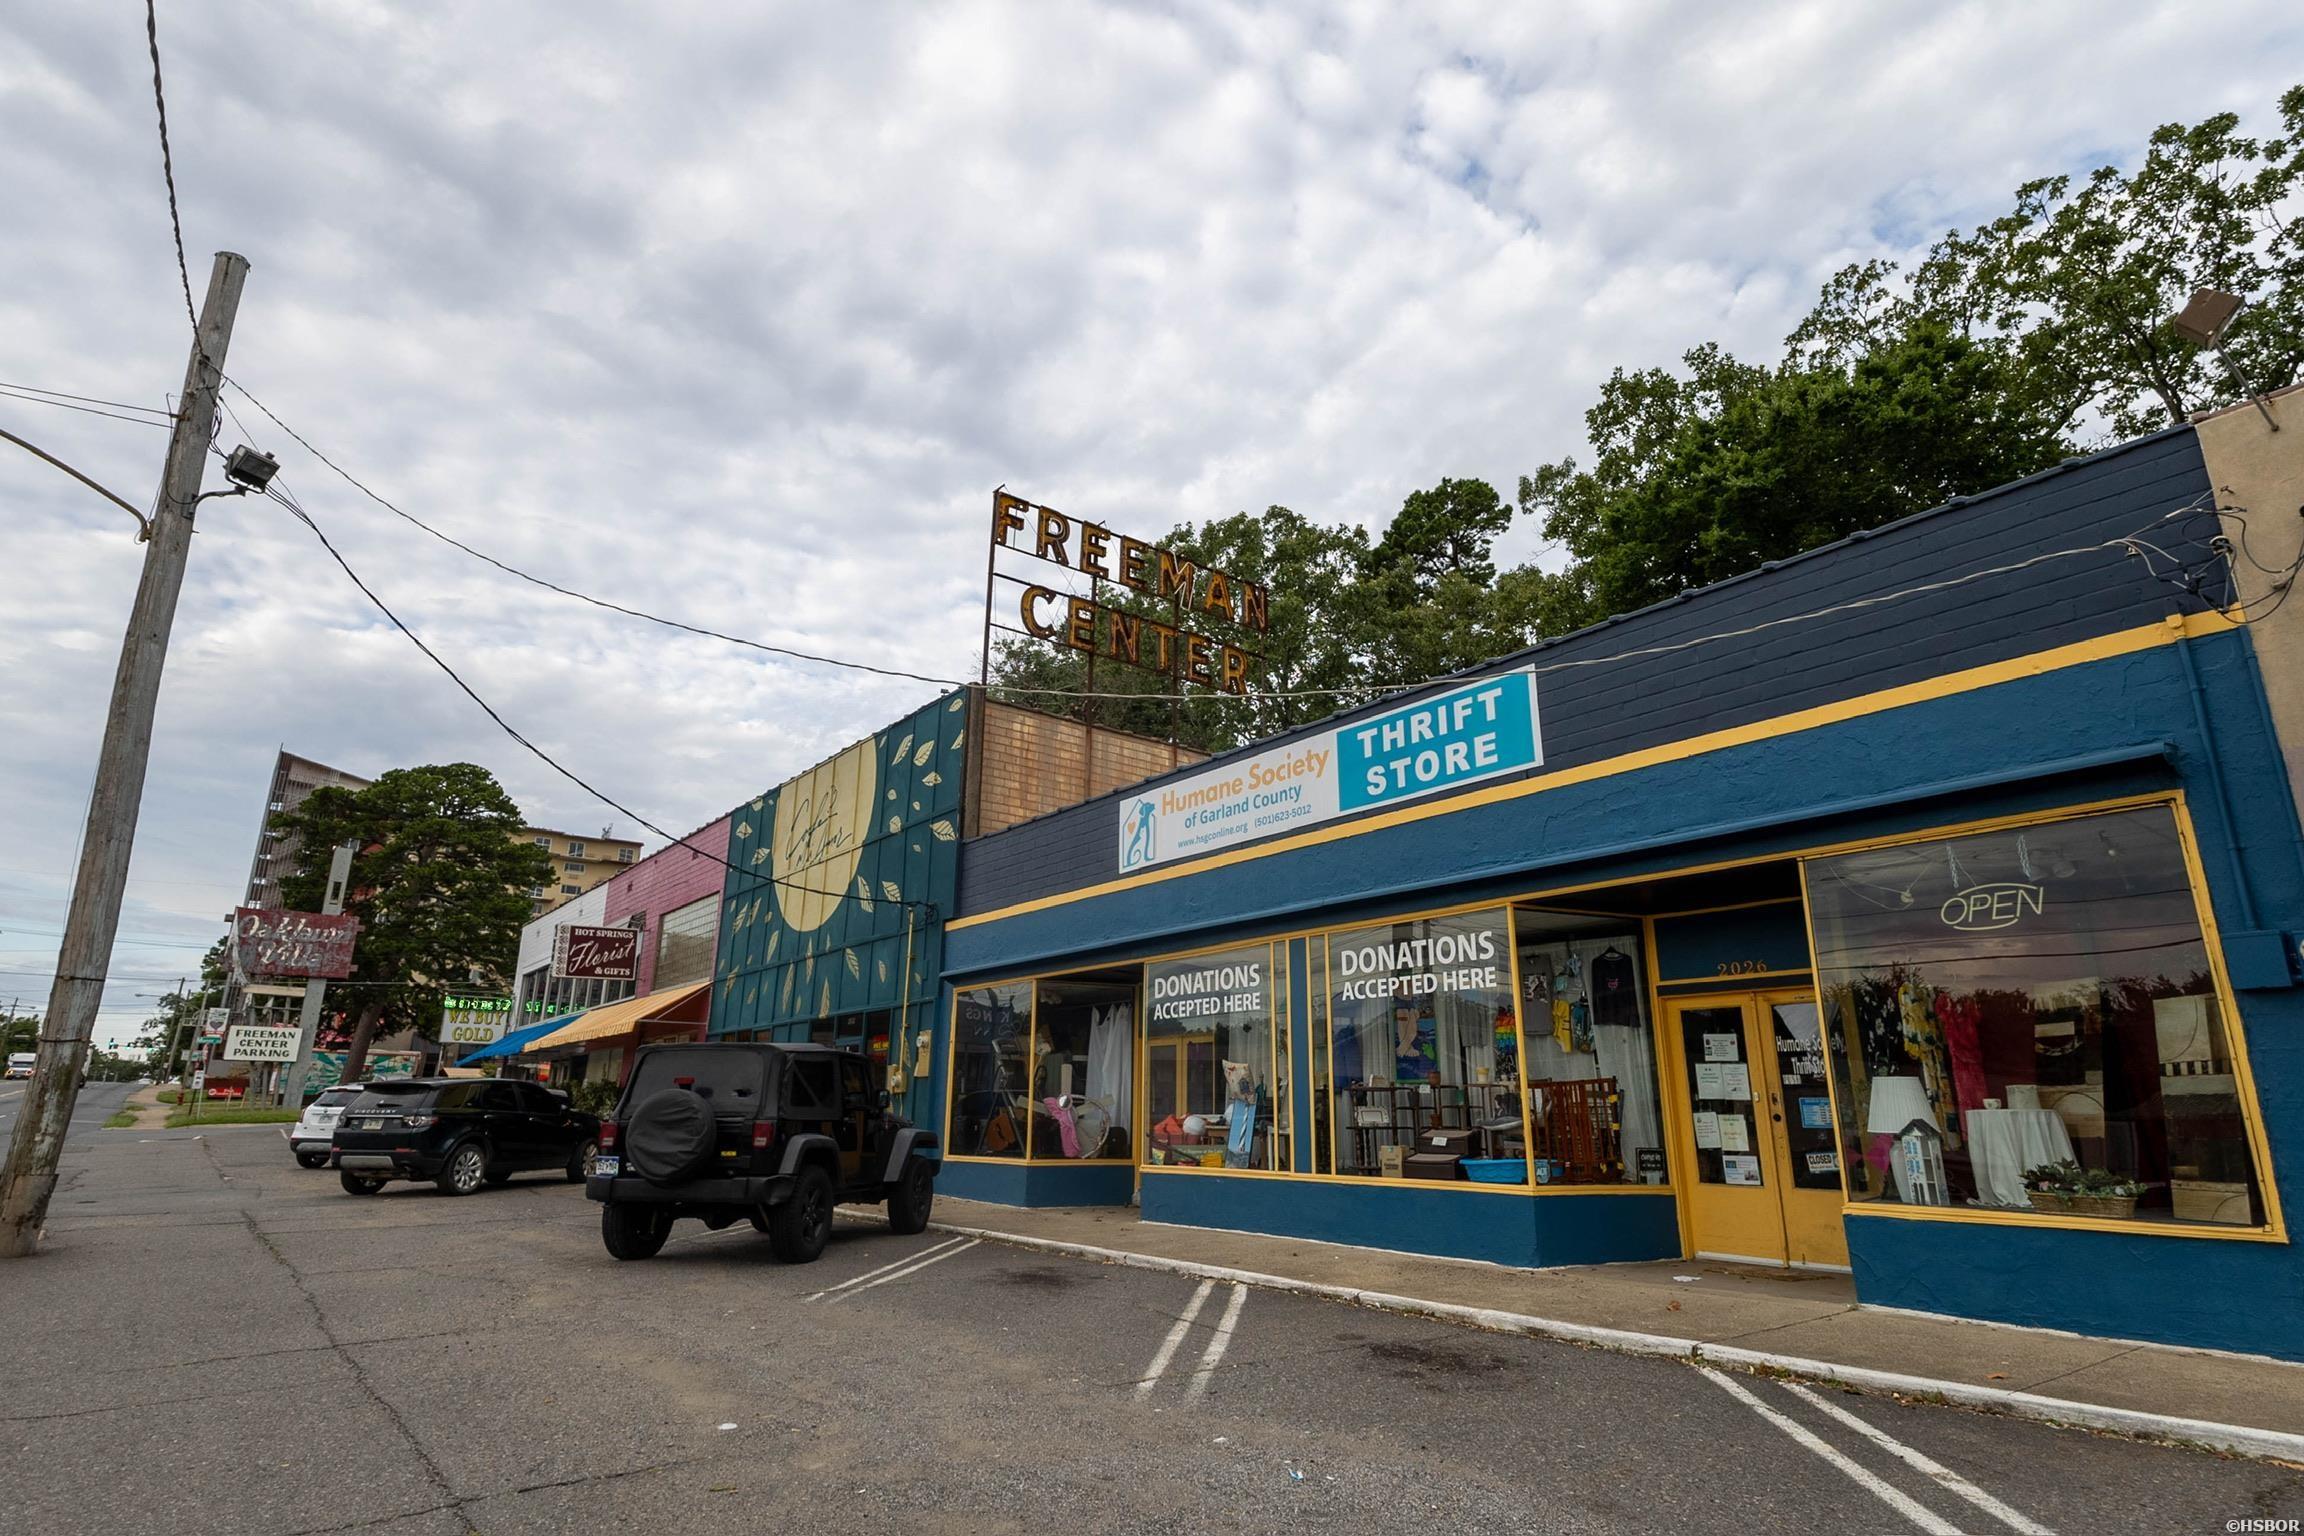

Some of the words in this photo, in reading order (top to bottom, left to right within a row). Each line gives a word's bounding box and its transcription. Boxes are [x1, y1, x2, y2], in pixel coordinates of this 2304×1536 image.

[995, 492, 1269, 633] FREEMAN
[1021, 585, 1248, 696] CENTER
[1357, 687, 1502, 758] THRIFT
[1366, 732, 1499, 796] STORE
[1161, 777, 1244, 816] Humane
[1248, 749, 1330, 791] Society
[1184, 811, 1198, 829] of
[1199, 797, 1250, 824] Garland
[1253, 784, 1302, 809] County
[1177, 822, 1249, 848] www.hsgconline.org
[1254, 804, 1312, 828] (501)623-5012
[1941, 887, 2043, 924] OPEN
[575, 928, 595, 937] HOT
[596, 930, 634, 939] SPRINGS
[569, 939, 635, 973] Florist
[1341, 931, 1495, 976] DONATIONS
[1717, 959, 1767, 976] 2026
[594, 967, 602, 975] &
[604, 967, 631, 976] GIFTS
[1154, 963, 1261, 999] DONATIONS
[1342, 973, 1438, 1001] ACCEPTED
[1443, 966, 1497, 992] HERE
[449, 1010, 470, 1024] WE
[473, 1011, 504, 1025] BUY
[1154, 997, 1220, 1020] ACCEPTED
[1223, 992, 1261, 1013] HERE
[235, 1029, 296, 1039] FREEMAN
[239, 1039, 288, 1048] CENTER
[452, 1027, 494, 1042] GOLD
[1776, 1035, 1811, 1052] Humane
[233, 1049, 290, 1058] PARKING
[1808, 1154, 1832, 1165] CLOSED
